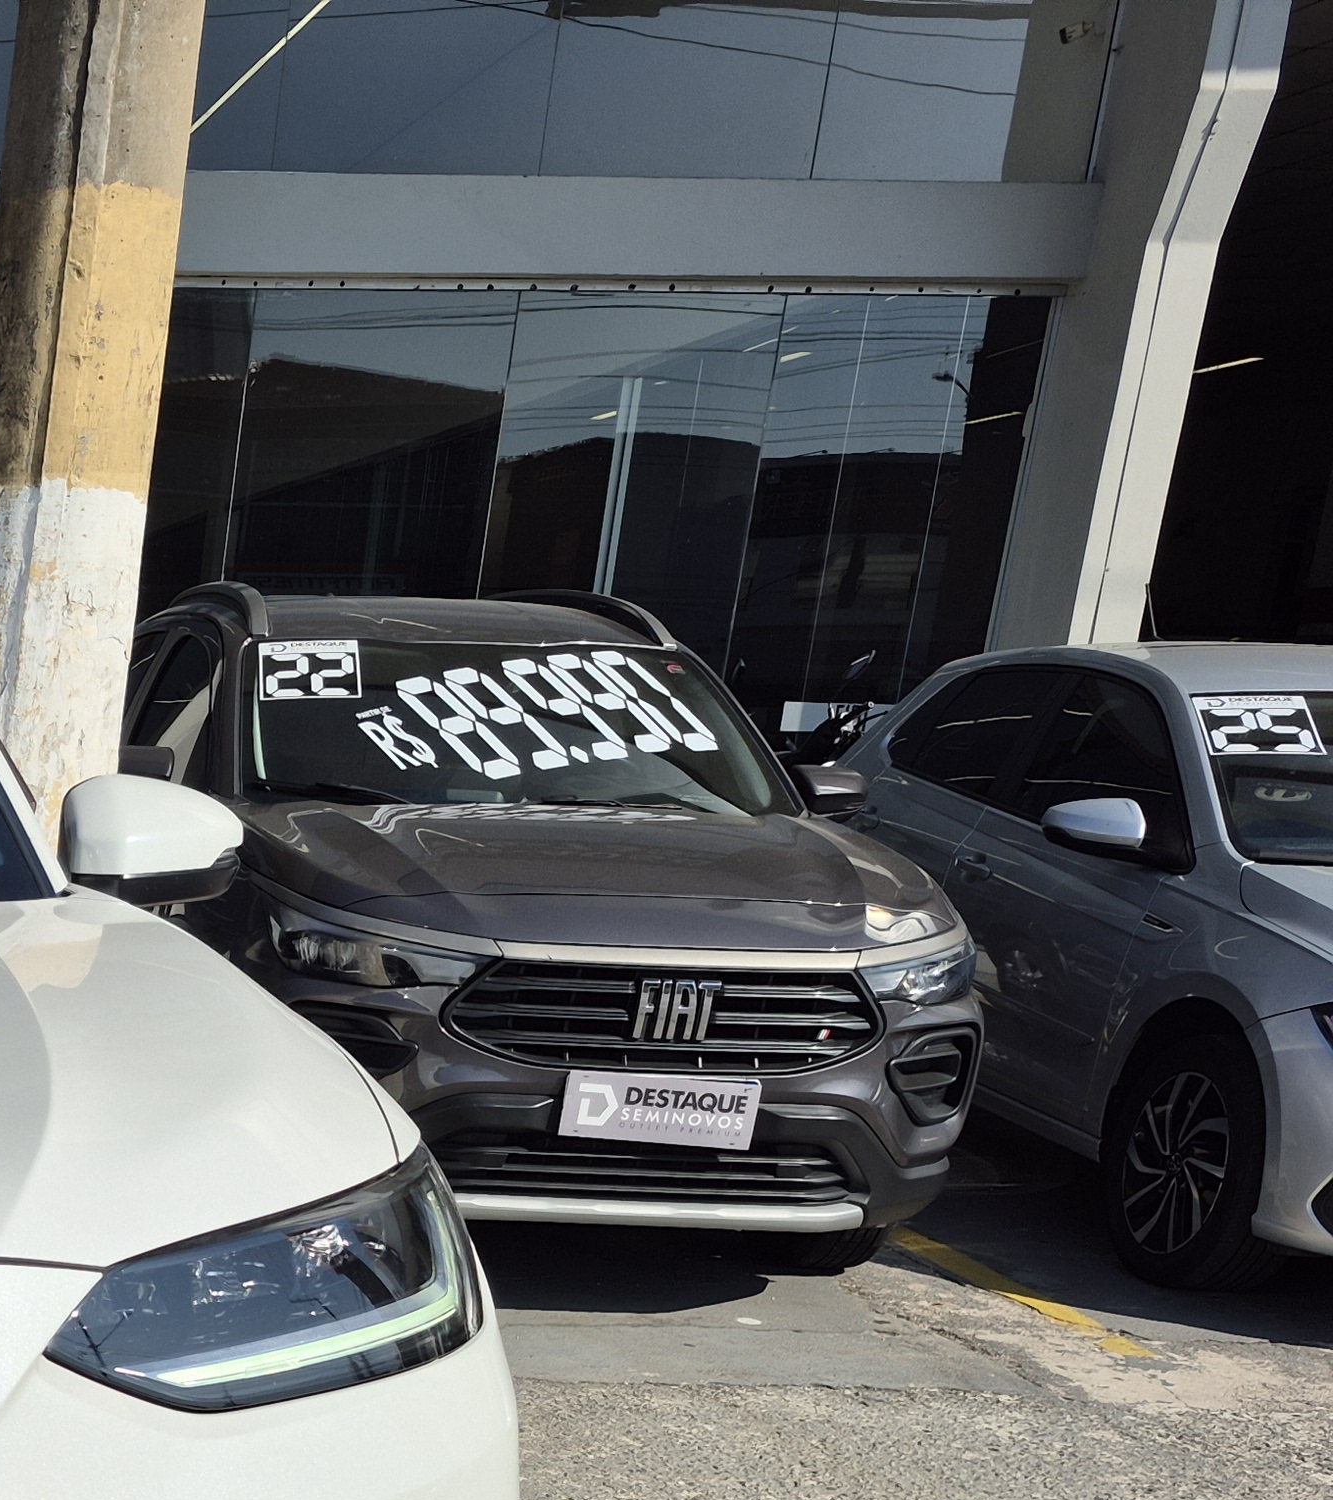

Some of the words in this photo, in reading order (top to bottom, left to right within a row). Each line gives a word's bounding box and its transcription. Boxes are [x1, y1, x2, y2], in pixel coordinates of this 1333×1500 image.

[266, 652, 354, 697] 22
[395, 651, 719, 780] 89.990
[1209, 708, 1316, 752] 25
[358, 712, 439, 770] R$
[632, 978, 723, 1041] FIAT
[620, 1107, 744, 1130] SEMINOVOS
[624, 1086, 748, 1114] DESTAQUE
[618, 1122, 669, 1132] OUTLET
[680, 1127, 741, 1137] PREMIUM
